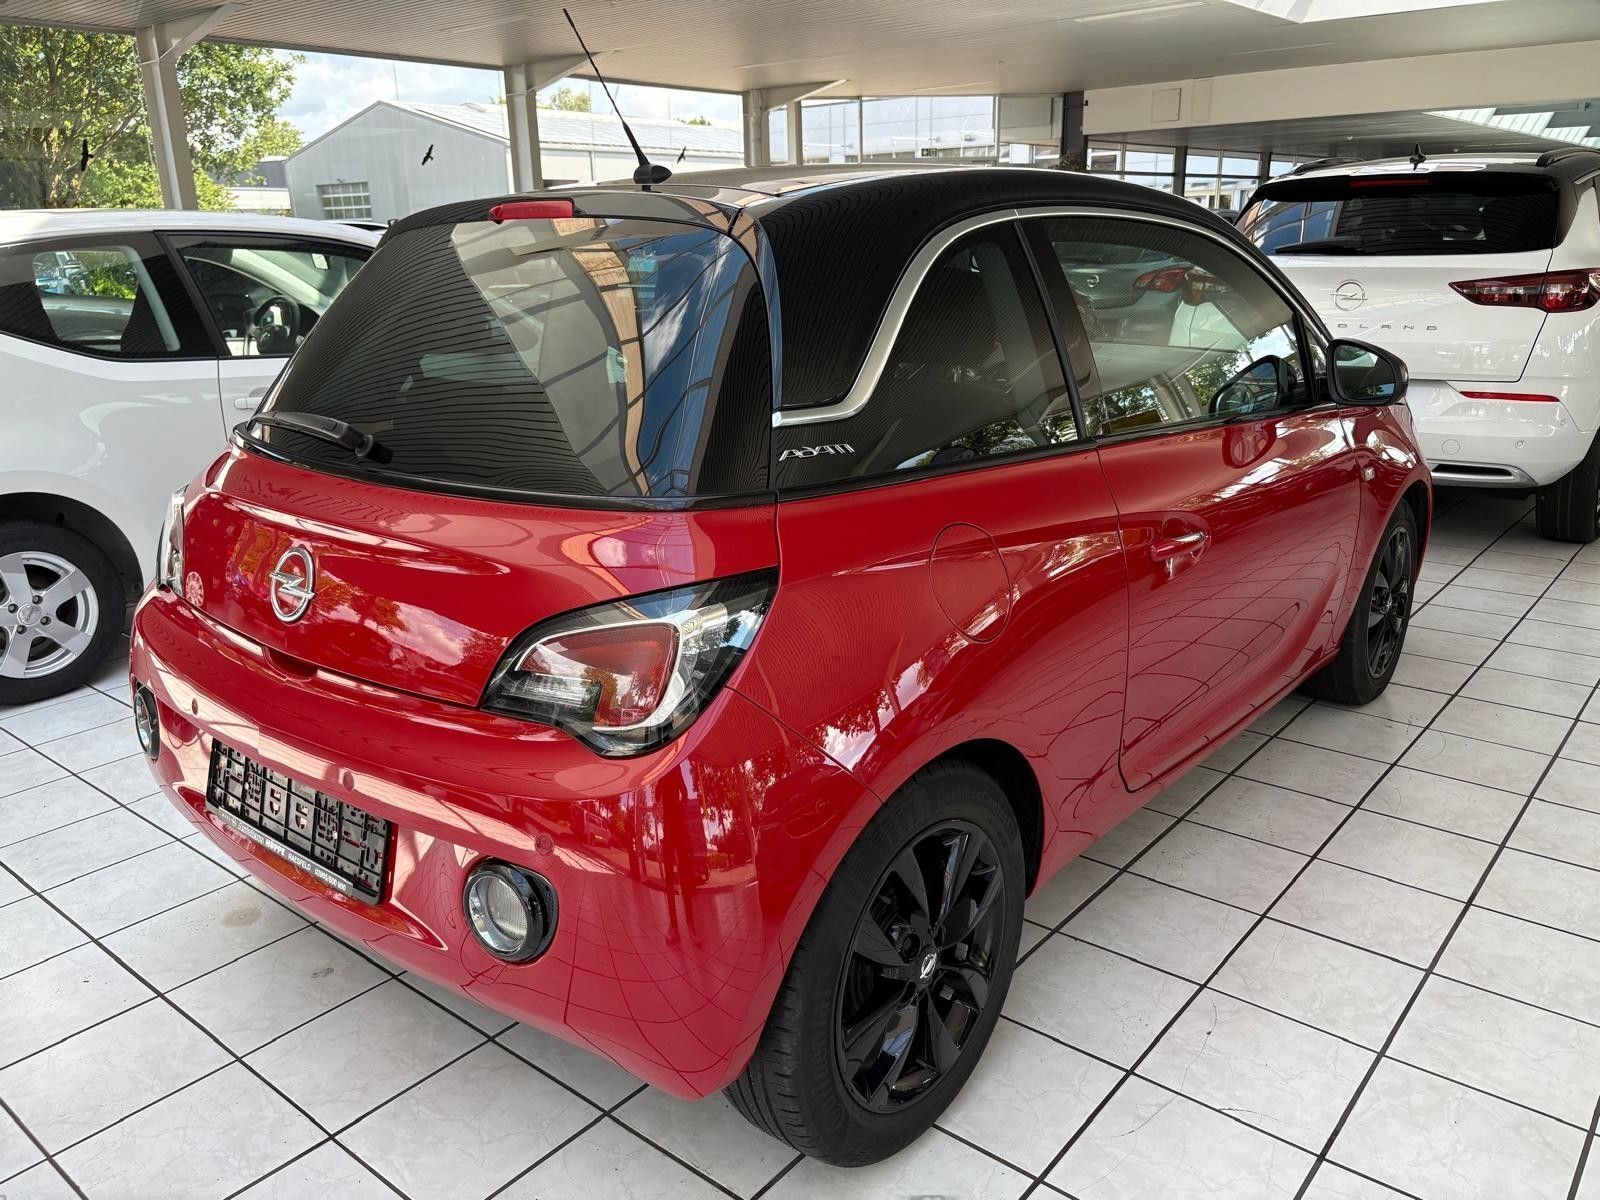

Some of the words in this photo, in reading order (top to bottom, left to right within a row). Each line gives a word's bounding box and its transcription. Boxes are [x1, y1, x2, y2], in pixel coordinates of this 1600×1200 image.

[1337, 323, 1438, 331] DLAND
[778, 443, 856, 462] ADAM
[288, 853, 311, 871] RAESFELD
